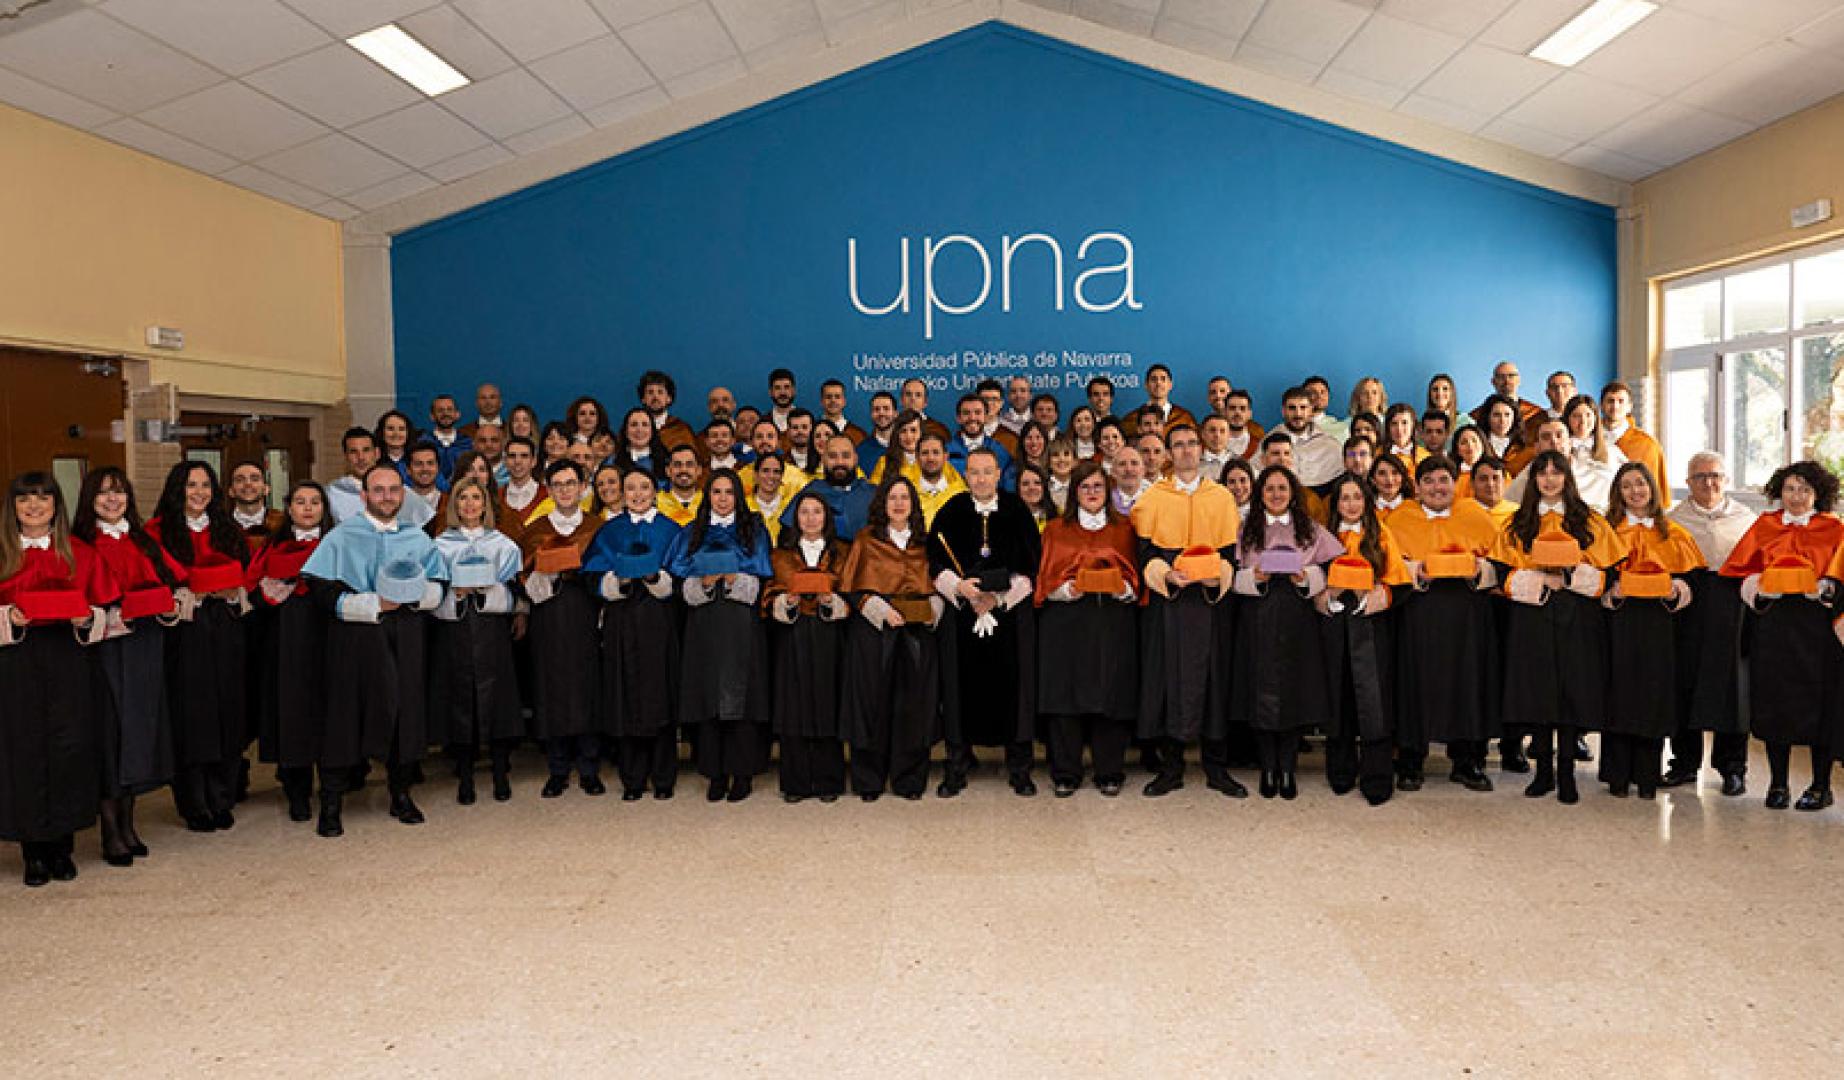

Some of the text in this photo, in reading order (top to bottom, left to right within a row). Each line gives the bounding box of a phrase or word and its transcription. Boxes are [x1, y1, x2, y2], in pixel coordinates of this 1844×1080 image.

[848, 231, 1143, 340] upna
[853, 350, 1132, 369] Universidad Pública de Navarra
